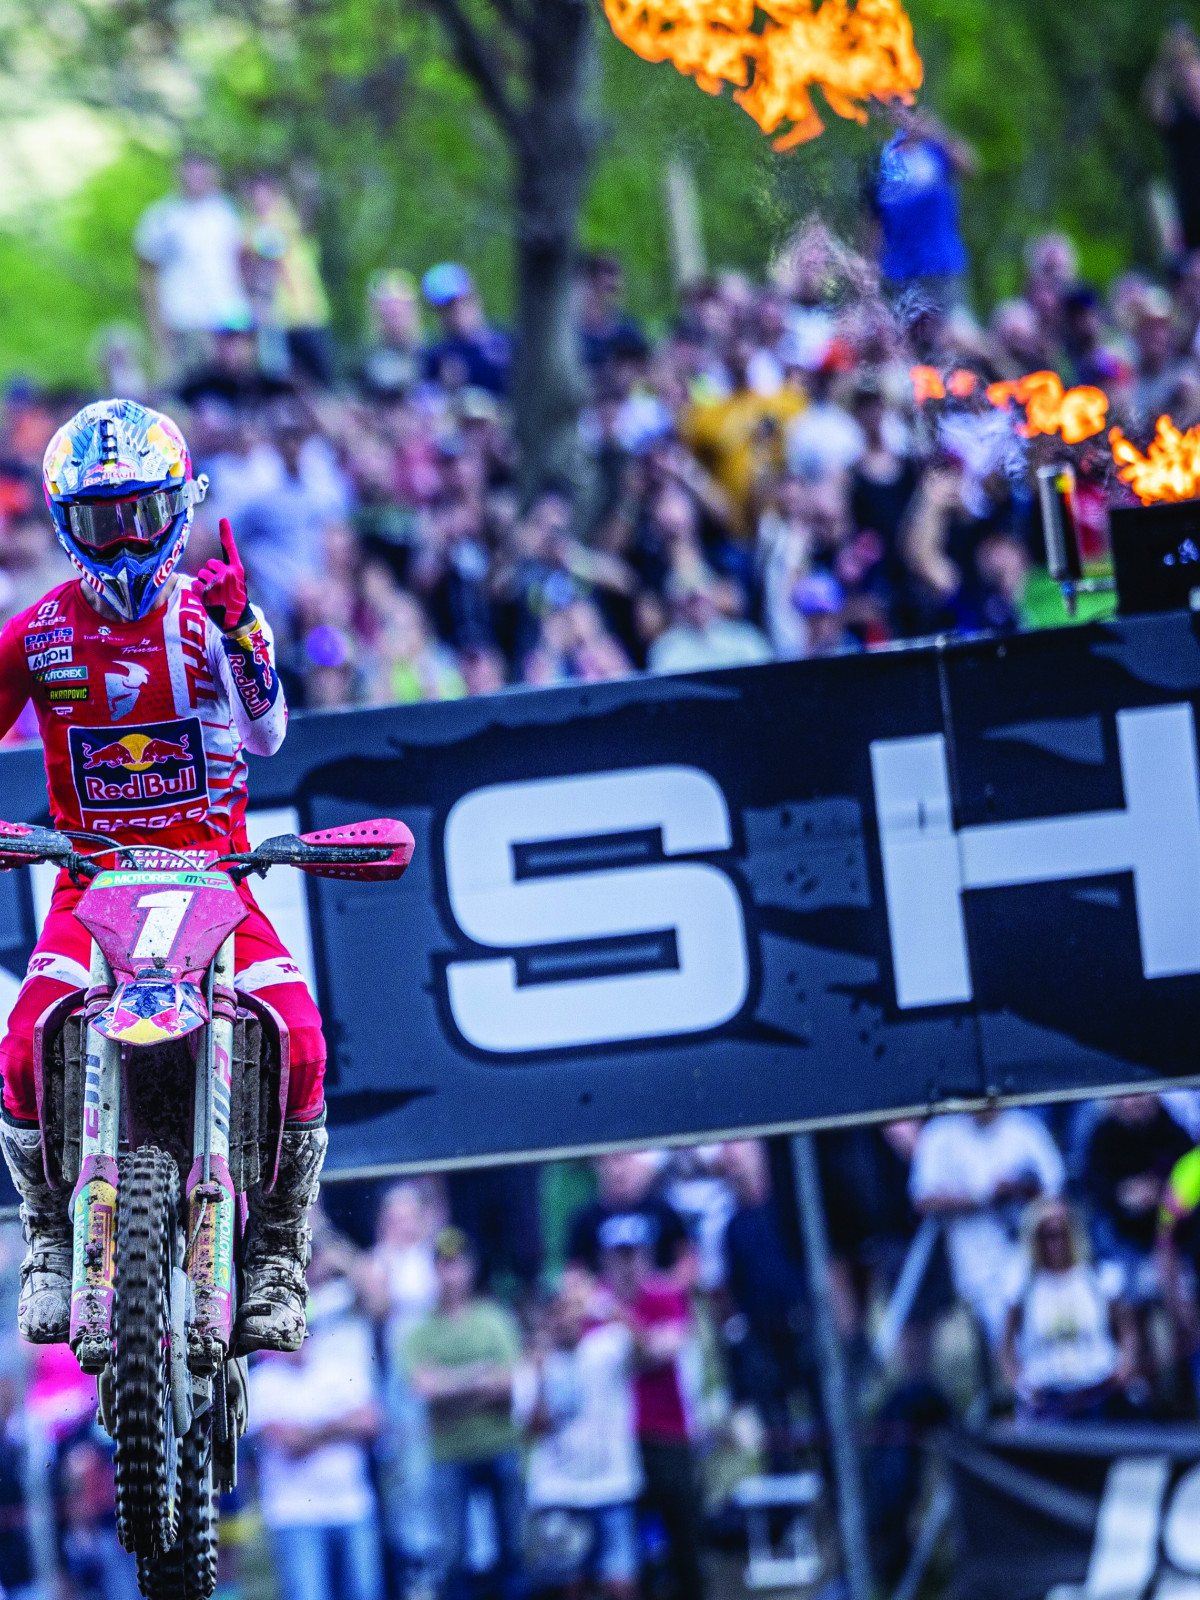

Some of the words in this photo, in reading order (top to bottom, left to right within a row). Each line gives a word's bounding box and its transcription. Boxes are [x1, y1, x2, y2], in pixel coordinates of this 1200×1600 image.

[27, 615, 67, 629] GASGAS
[44, 669, 83, 681] MTOREX
[228, 653, 256, 688] Red
[240, 677, 272, 718] Bull
[84, 774, 143, 801] Red
[142, 765, 197, 799] Bull
[92, 807, 202, 832] GASGAS
[114, 873, 180, 885] MOTOREX
[131, 889, 195, 959] 1
[217, 1196, 233, 1266] MOTOREX
